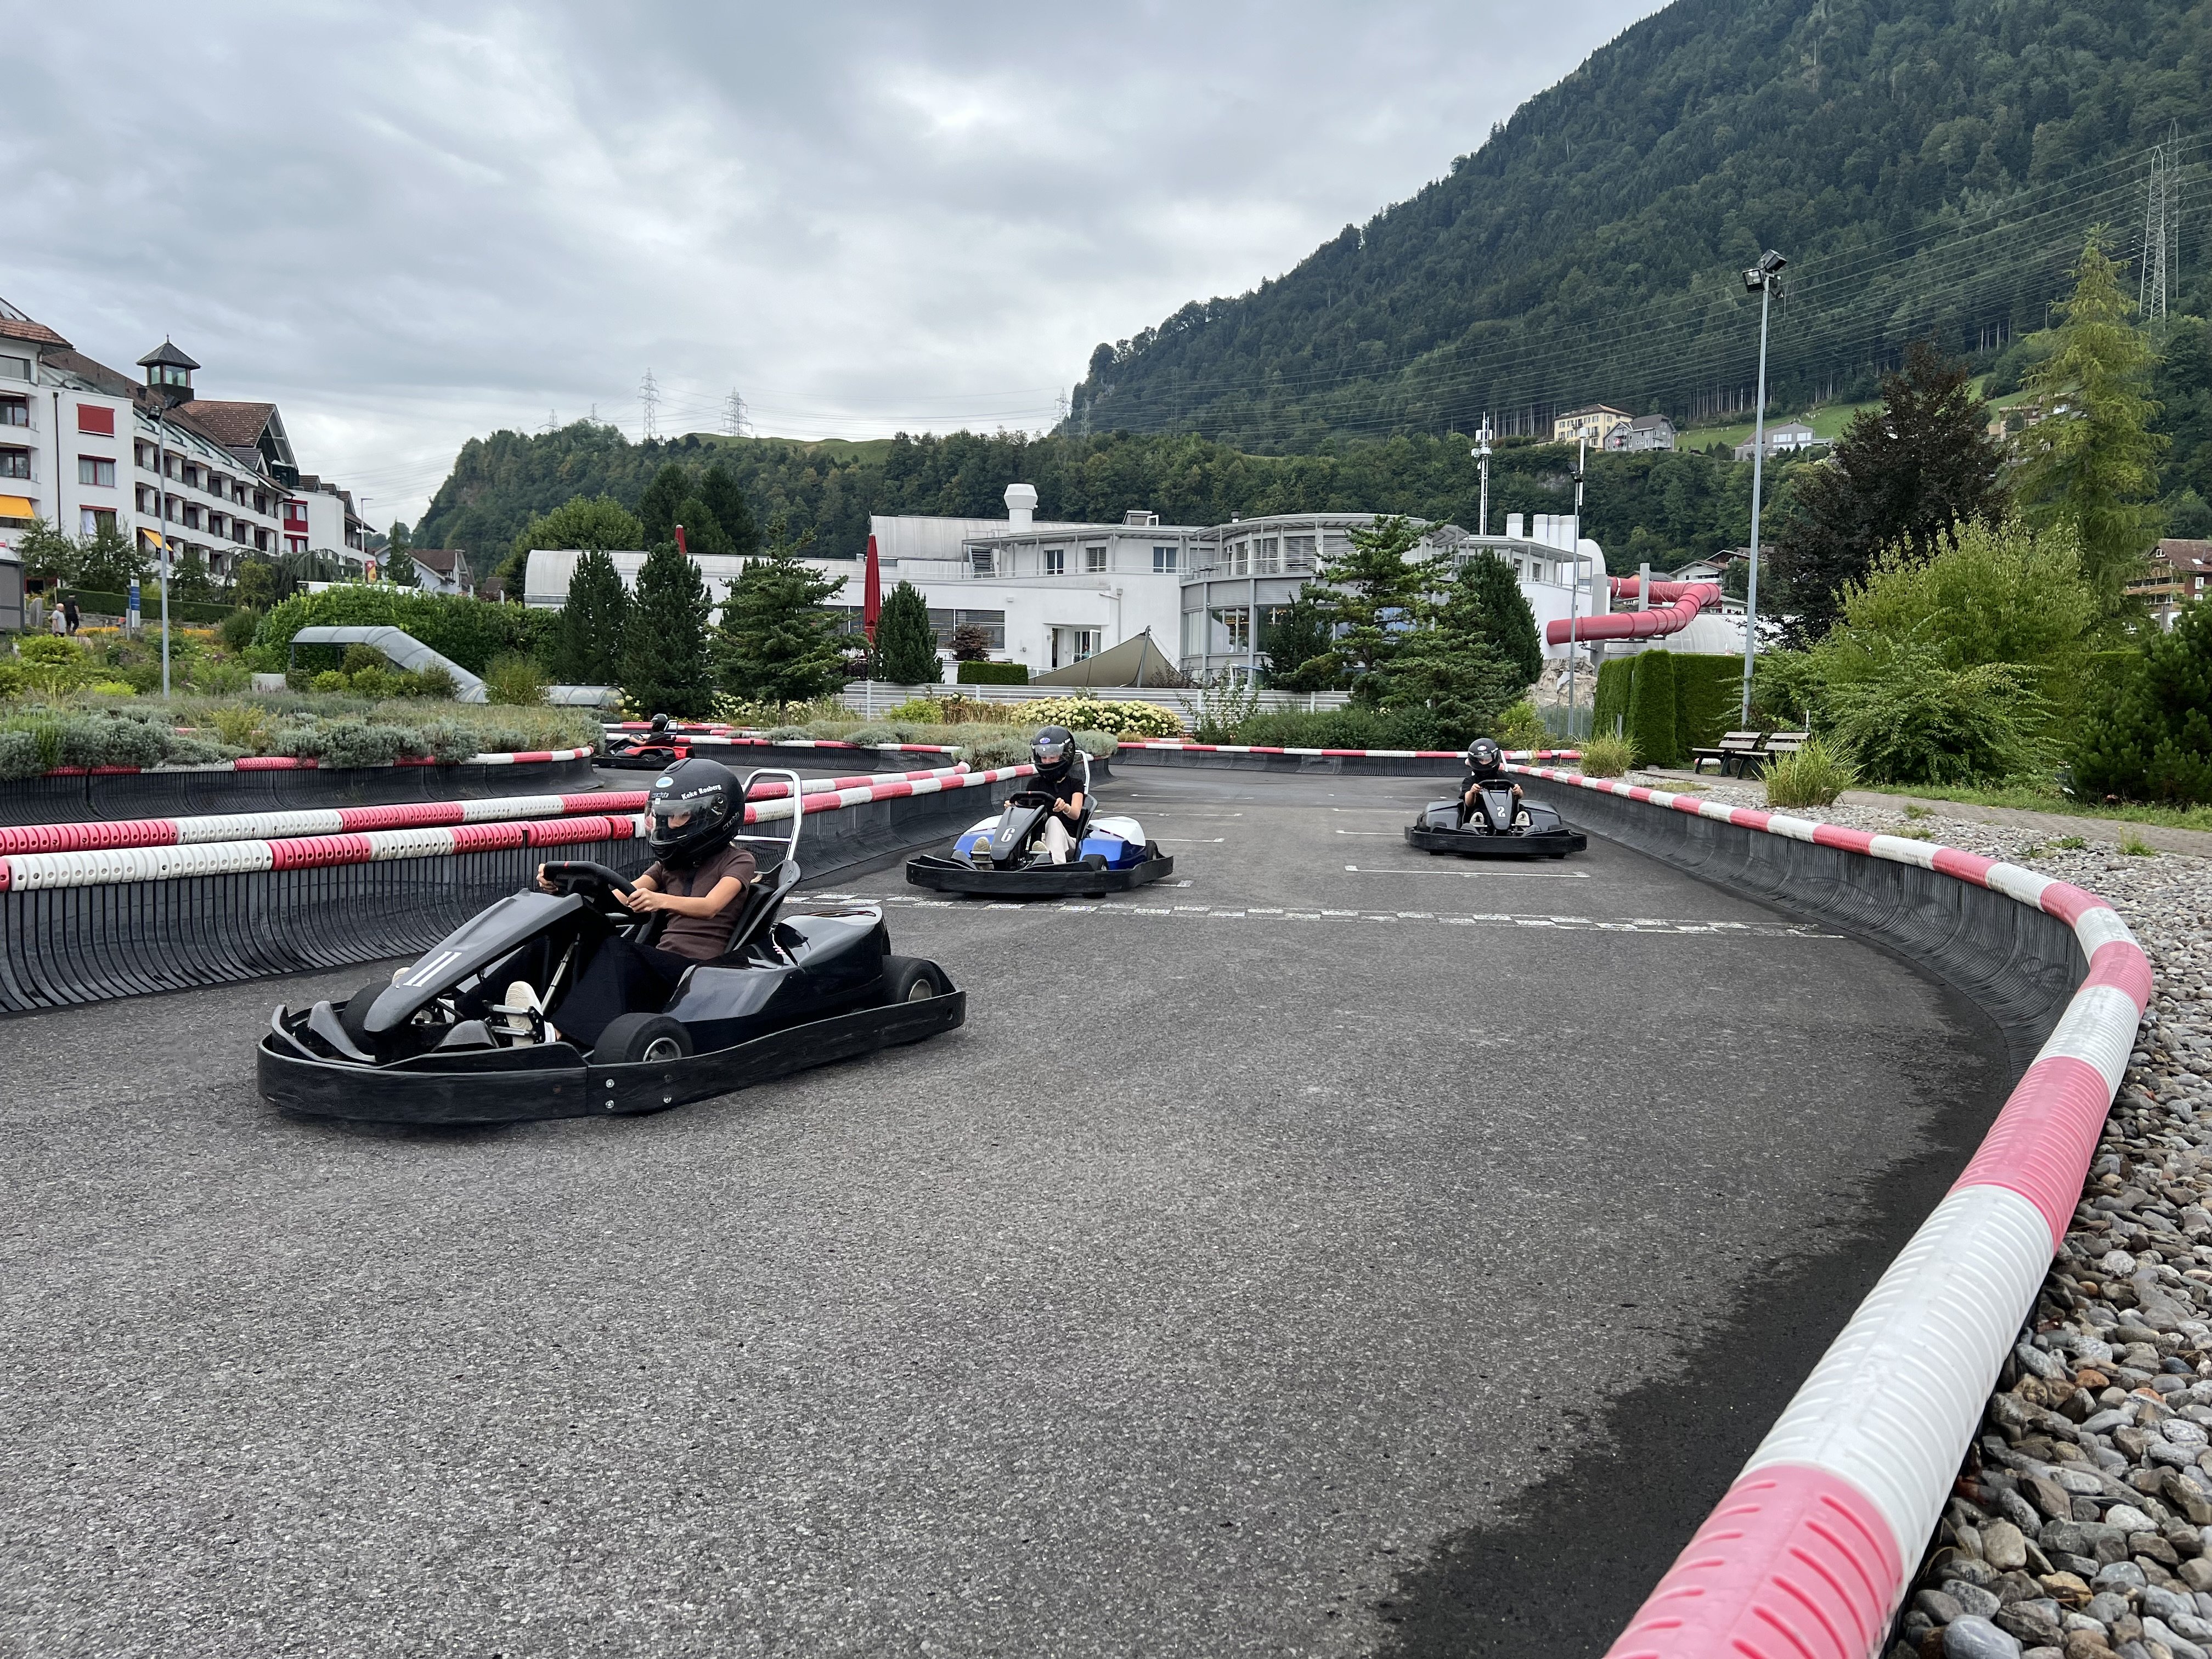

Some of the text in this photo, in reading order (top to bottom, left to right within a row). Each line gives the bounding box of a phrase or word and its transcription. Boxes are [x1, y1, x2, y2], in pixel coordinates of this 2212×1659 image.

[681, 791, 698, 800] Keke
[698, 784, 722, 794] Rosberg
[1497, 806, 1506, 817] 2
[1001, 828, 1015, 842] 6
[403, 951, 462, 987] 11
